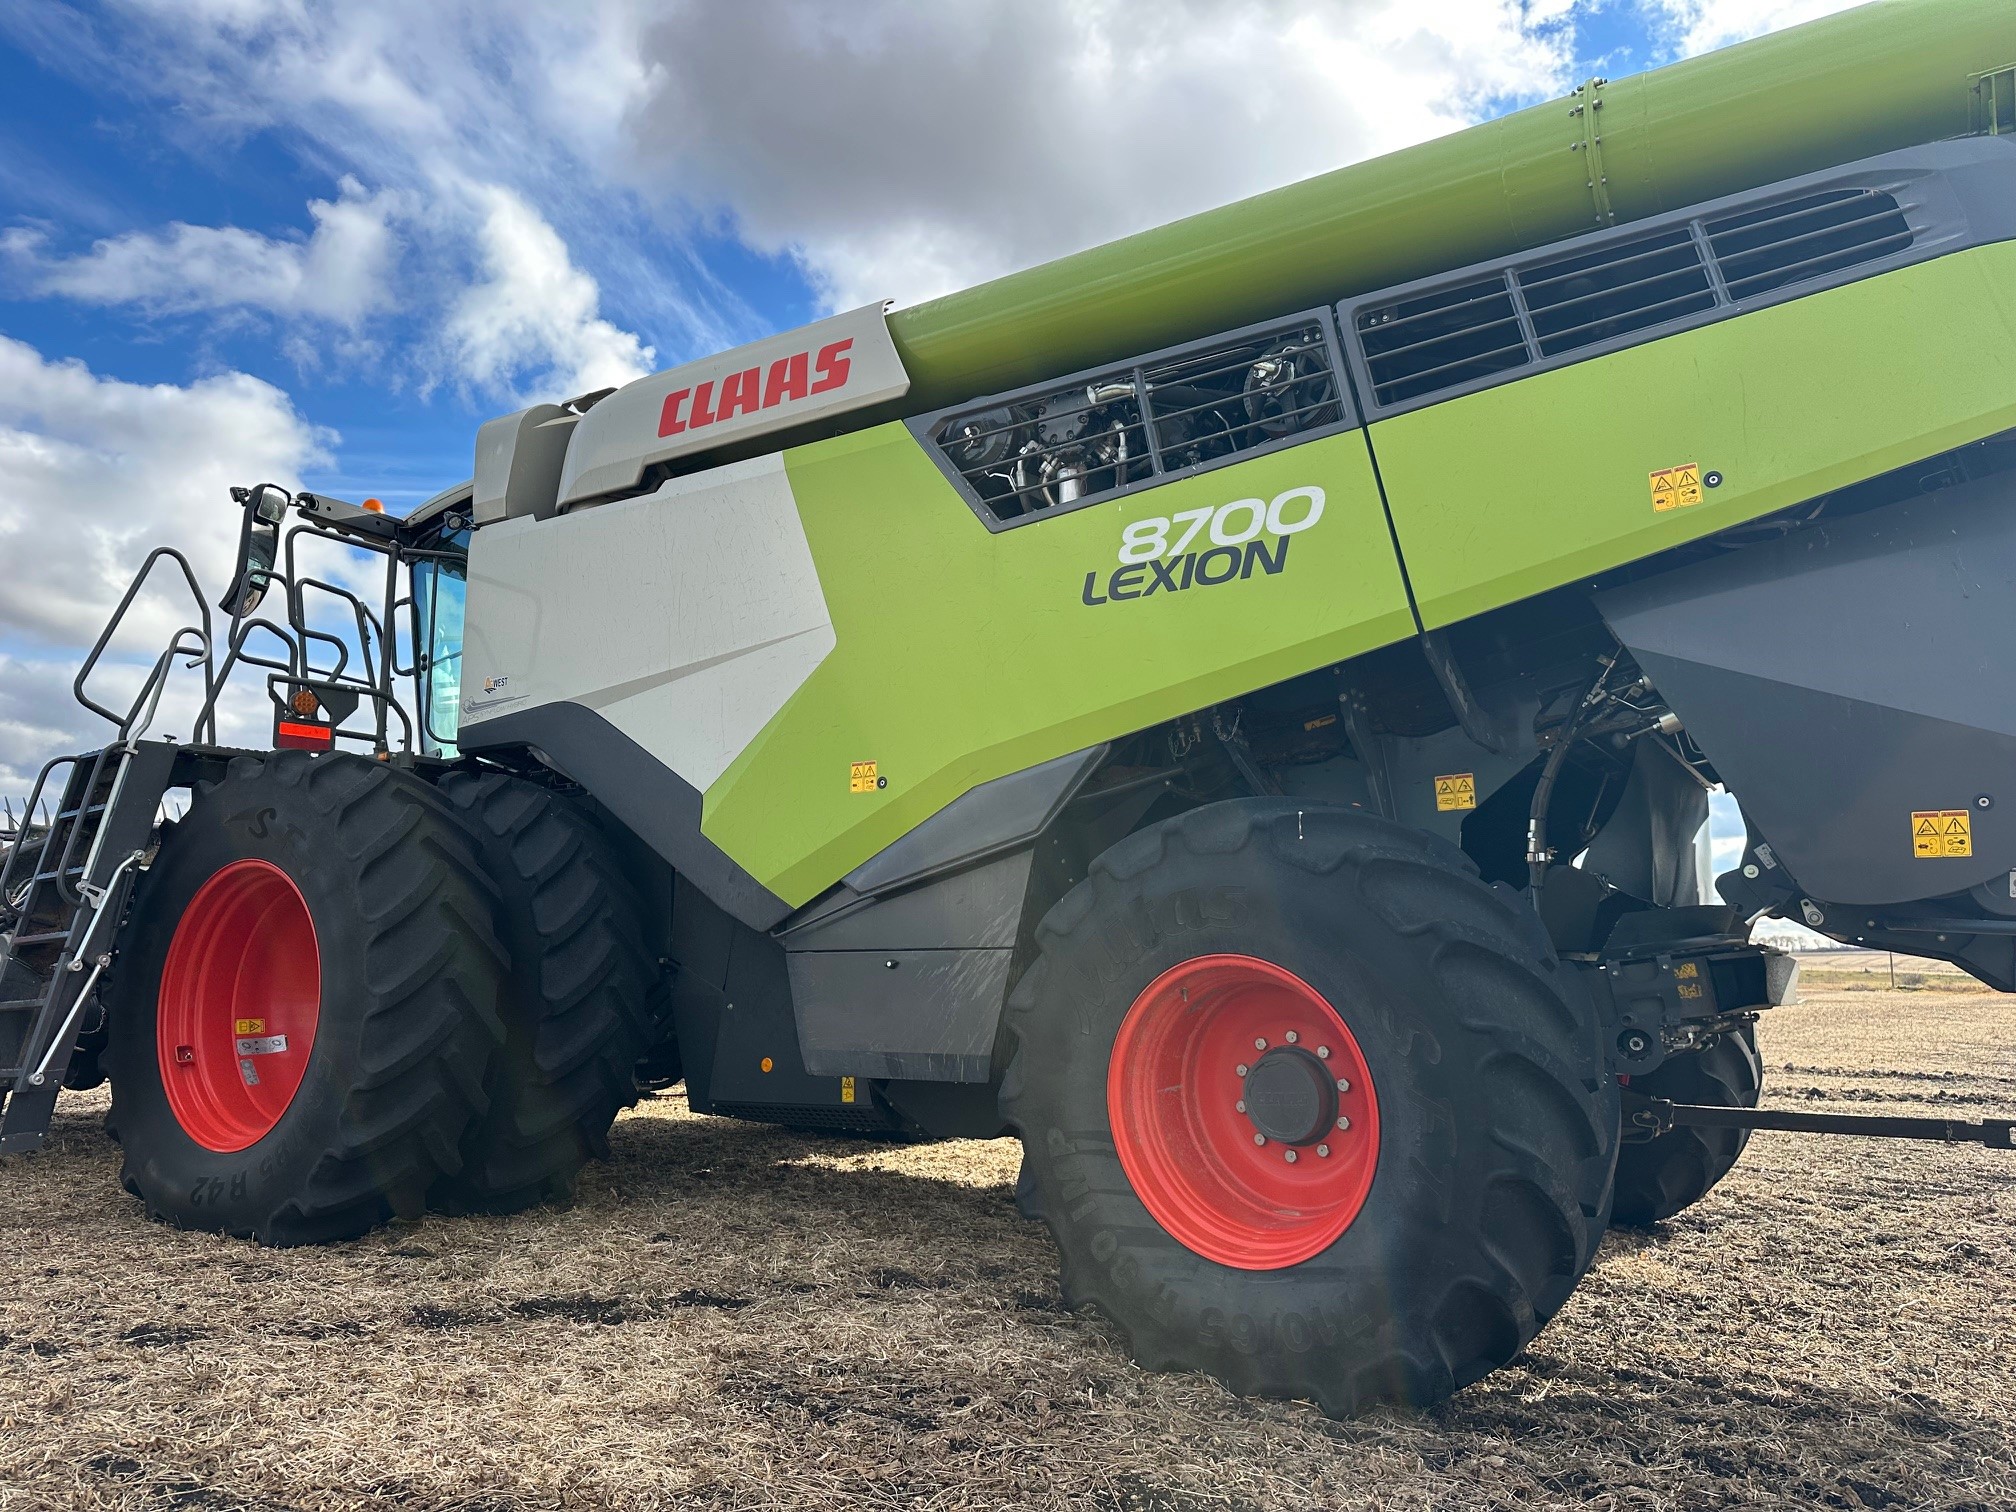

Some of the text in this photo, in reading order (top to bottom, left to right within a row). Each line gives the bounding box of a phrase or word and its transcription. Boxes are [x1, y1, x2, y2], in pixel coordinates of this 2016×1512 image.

[658, 337, 854, 438] CLAAS
[1118, 486, 1326, 564] 8700
[1082, 535, 1290, 606] LEXION
[461, 713, 479, 725] APS
